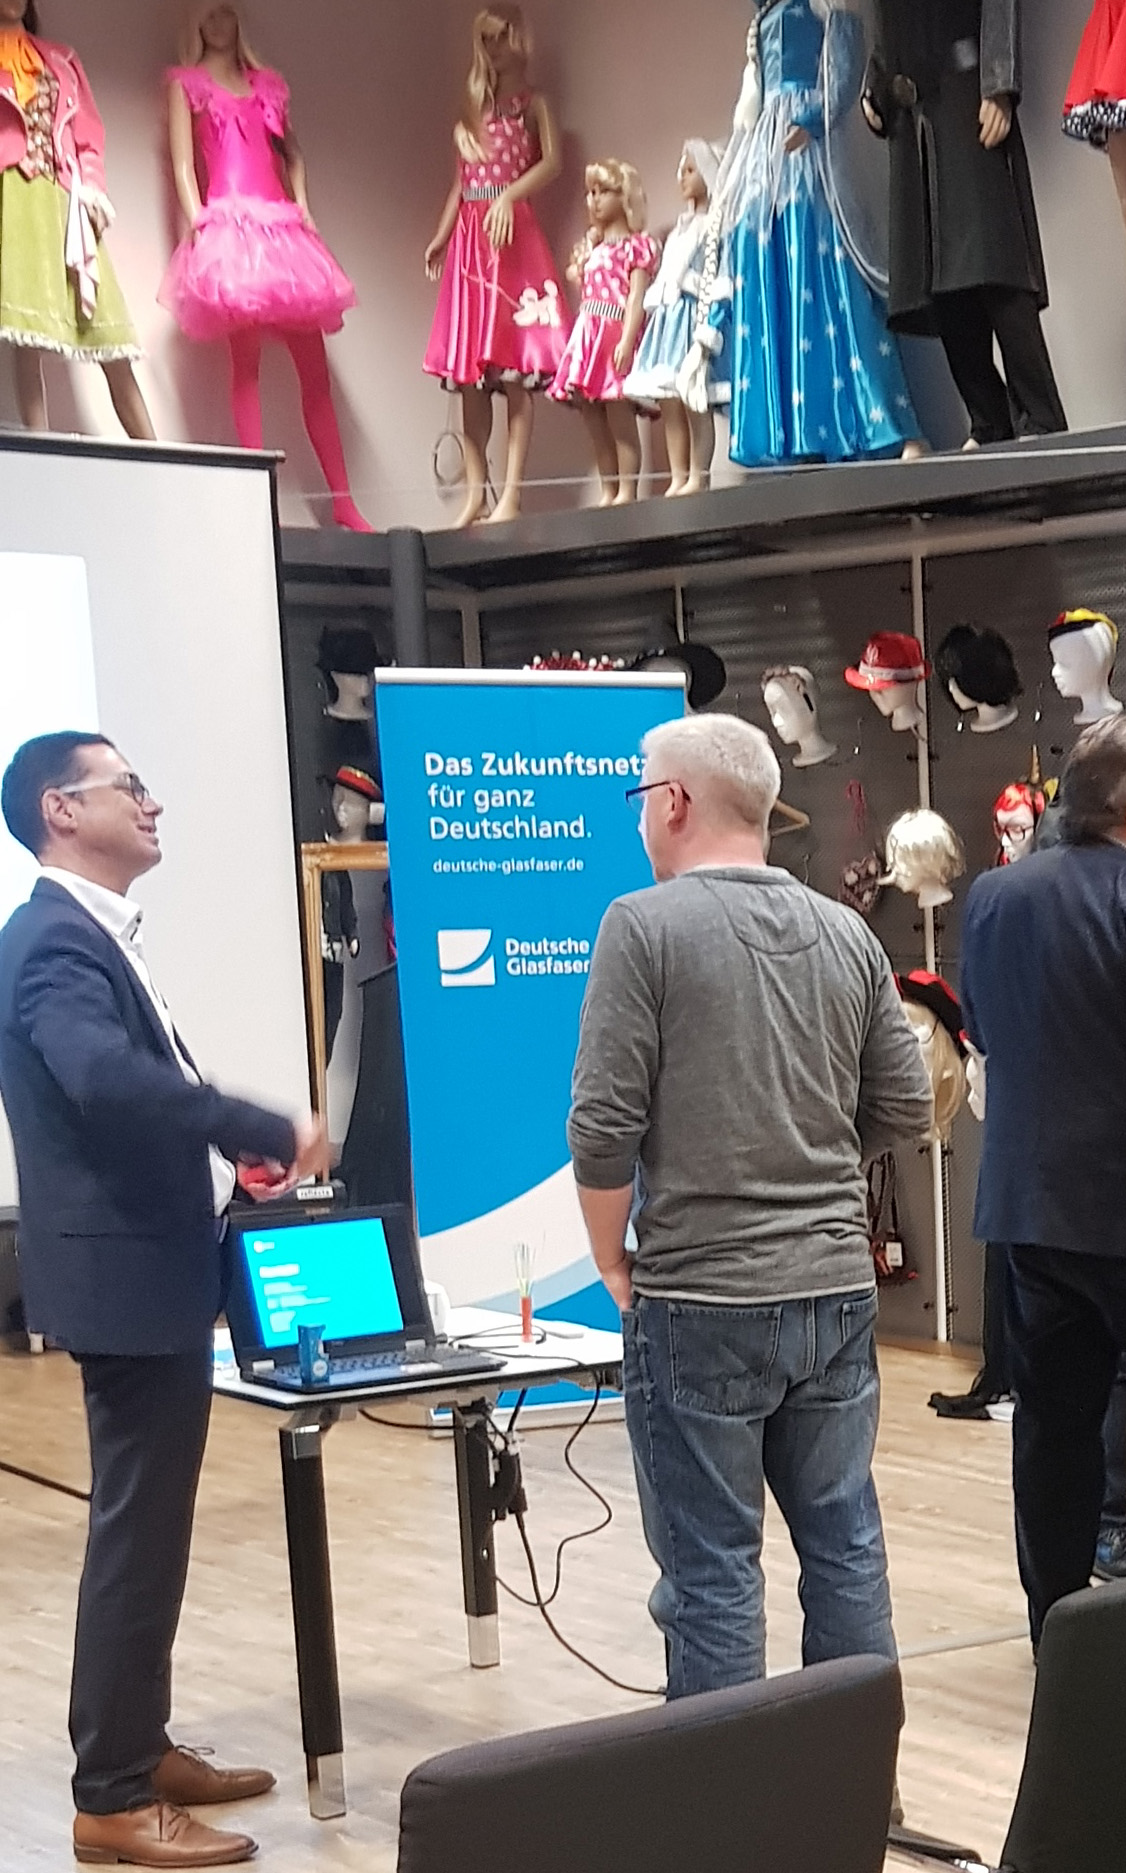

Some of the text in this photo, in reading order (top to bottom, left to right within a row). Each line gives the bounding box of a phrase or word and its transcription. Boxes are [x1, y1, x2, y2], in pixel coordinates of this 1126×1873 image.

[424, 751, 473, 776] Das
[427, 782, 536, 814] für ganz
[429, 813, 592, 840] Deutschland.
[432, 857, 585, 876] deutsche-glasfaser.de
[505, 936, 590, 956] Deutsche
[506, 956, 591, 976] Glasfaser
